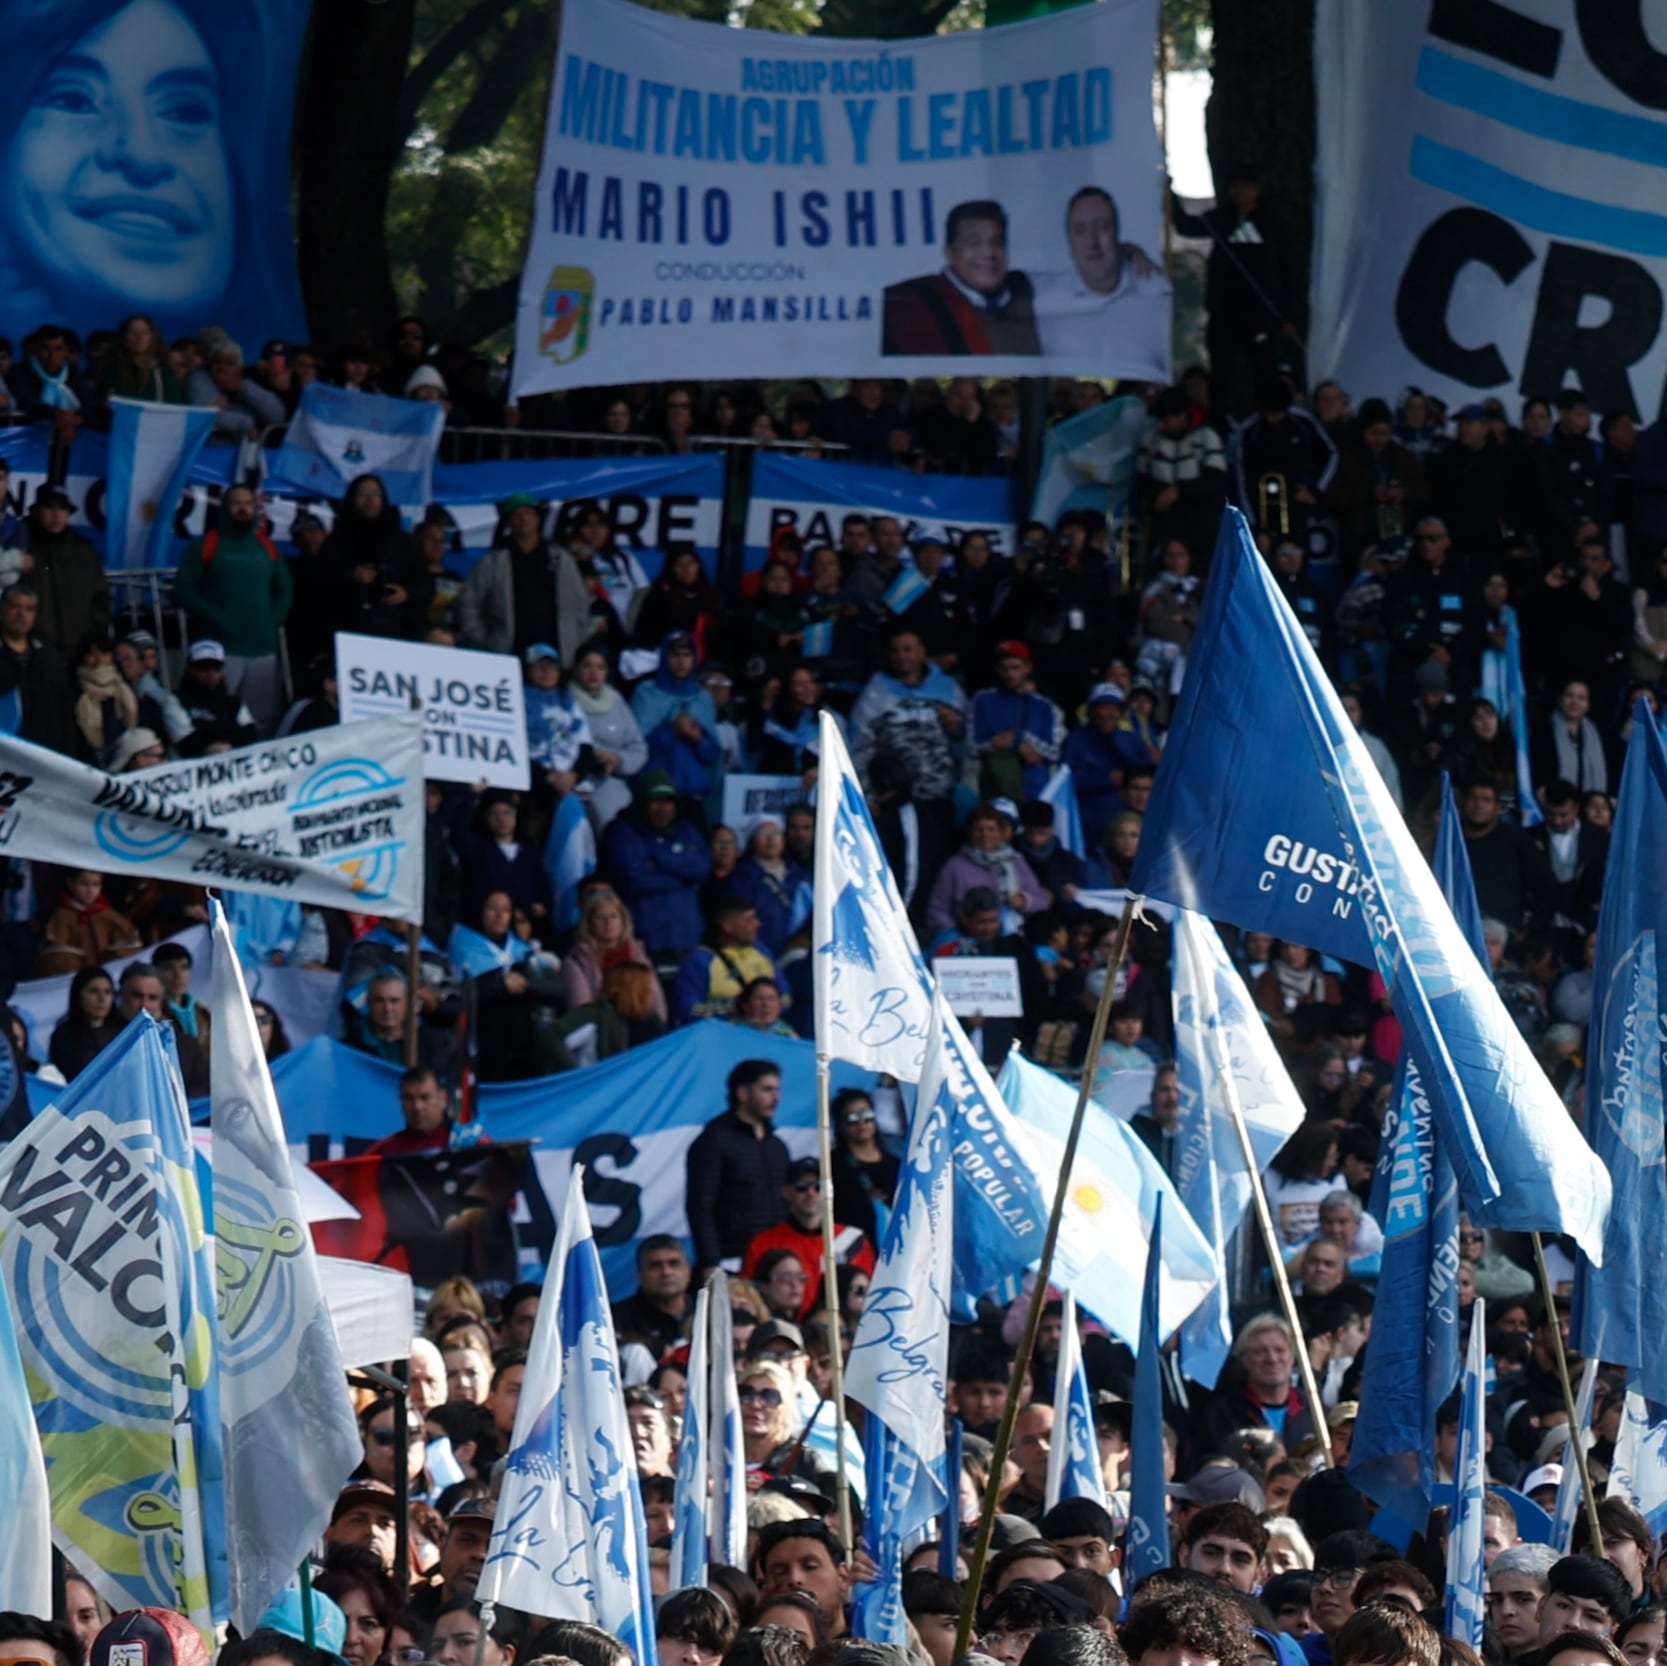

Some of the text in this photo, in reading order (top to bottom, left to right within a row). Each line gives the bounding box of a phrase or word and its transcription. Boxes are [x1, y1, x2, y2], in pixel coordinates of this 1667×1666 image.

[741, 50, 916, 94] AGRUPACIÓN
[558, 54, 1113, 165] MILITANCIA Y LEALTAD
[552, 168, 937, 248] MARIO ISHII
[655, 259, 805, 281] CONDUCCIÓN
[599, 296, 873, 327] PABLO MANSILLA
[349, 668, 513, 713] SAN JOSÉ
[421, 730, 516, 766] STINA
[952, 1138, 1036, 1240] POPULAR
